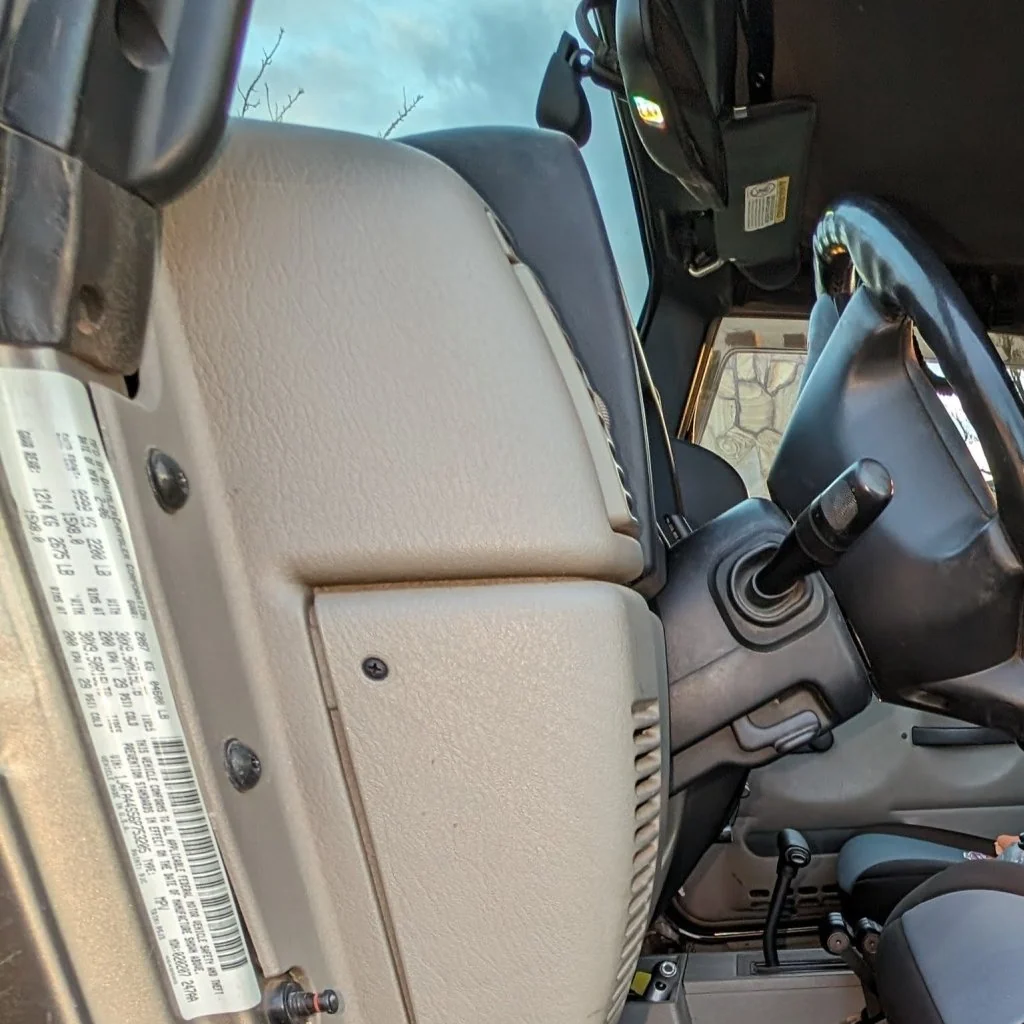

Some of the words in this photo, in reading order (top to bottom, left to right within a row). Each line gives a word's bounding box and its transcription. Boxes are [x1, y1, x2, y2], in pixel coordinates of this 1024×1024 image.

[32, 488, 54, 509] 1214
[40, 514, 59, 527] KG
[46, 537, 69, 559] 2675
[56, 564, 75, 575] LB
[93, 565, 112, 576] LB
[60, 512, 85, 544] 15X8.0
[85, 587, 101, 603] RIMS
[97, 630, 116, 646] 200
[112, 678, 128, 688] 29
[123, 711, 139, 725] COLD
[62, 630, 79, 646] 200
[77, 678, 92, 688] 29
[89, 712, 104, 727] COLD
[142, 661, 155, 670] KG
[157, 710, 169, 719] LB
[135, 739, 149, 753] THIS
[121, 742, 143, 778] PREVENTION
[140, 756, 157, 781] VEHICLE
[134, 781, 154, 812] STANDARDS
[149, 784, 167, 812] CONFORMS
[148, 826, 164, 846] EFFECT
[161, 825, 174, 835] ALL
[159, 860, 172, 869] THE
[165, 839, 185, 872] APPLICABLE
[114, 775, 151, 853] 1J4FA44S56P753205
[142, 859, 157, 875] TYPE:
[153, 896, 170, 910] MPV
[180, 980, 200, 1002] 247AA
[163, 873, 177, 886] DATE
[177, 875, 193, 897] FEDERAL
[171, 899, 192, 934] MANUFACTURE
[185, 901, 199, 917] MOTOR
[191, 920, 207, 942] VEHICLE
[199, 945, 214, 964] SAFETY
[206, 967, 218, 976] AND
[209, 979, 224, 994] THEFT
